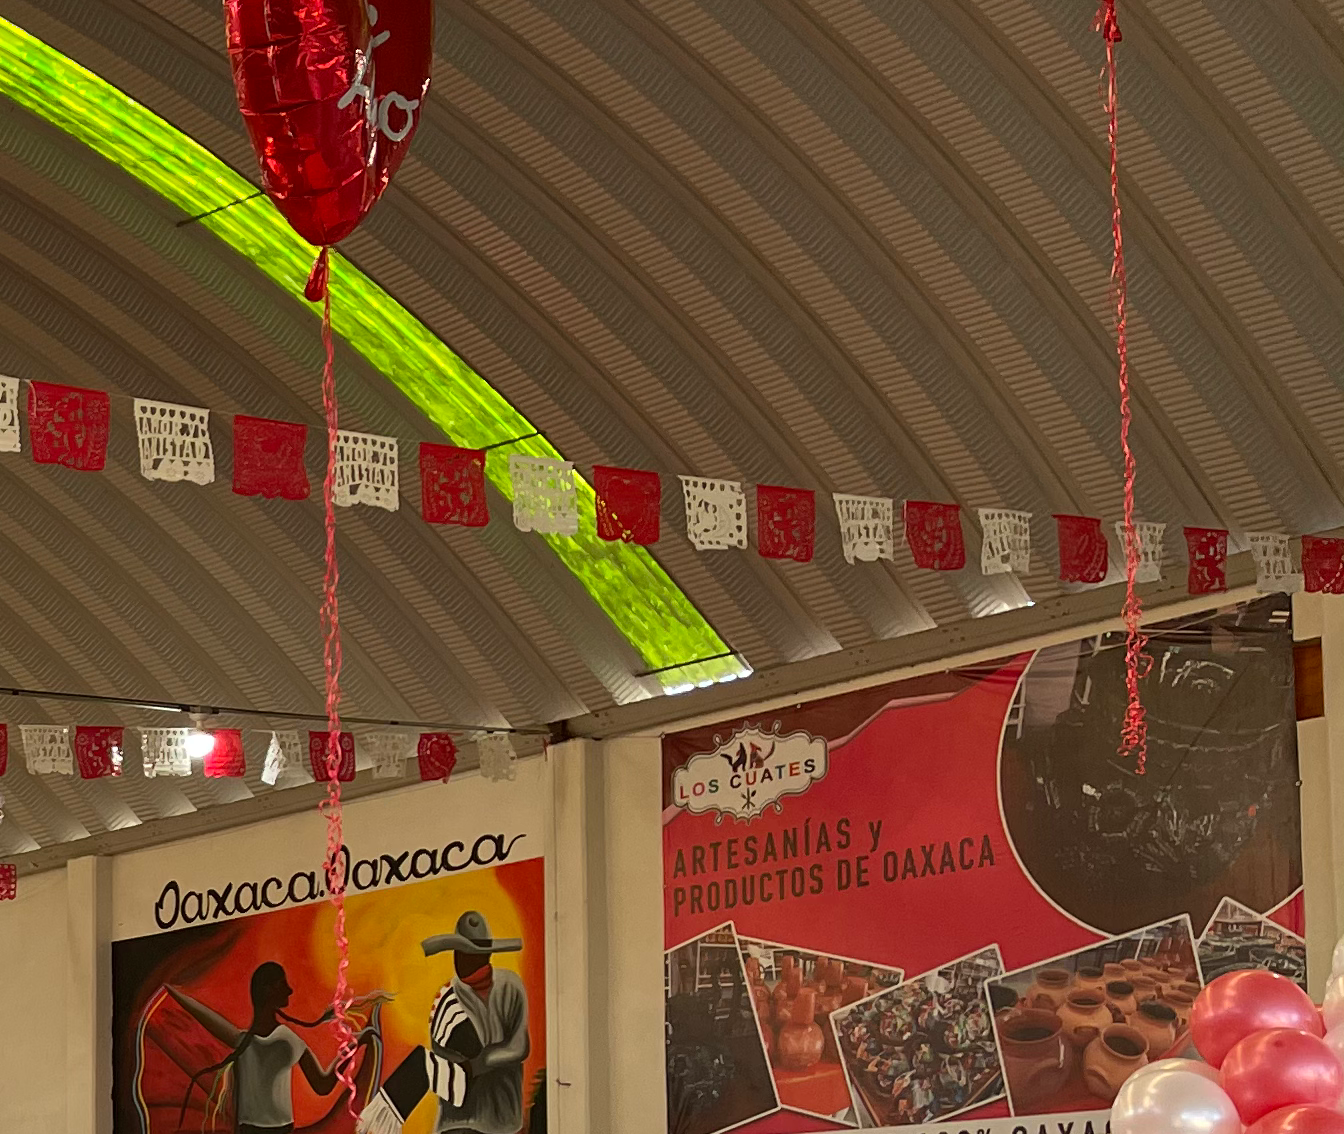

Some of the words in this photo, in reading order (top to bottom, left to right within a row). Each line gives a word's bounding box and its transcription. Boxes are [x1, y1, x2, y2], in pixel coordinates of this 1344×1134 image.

[679, 778, 720, 801] LOS
[729, 758, 816, 790] CUATES
[673, 817, 852, 879] ARTESANÍAS
[673, 862, 824, 918] PRODUCTOS
[836, 855, 870, 892] DE
[882, 834, 996, 883] OAXACA
